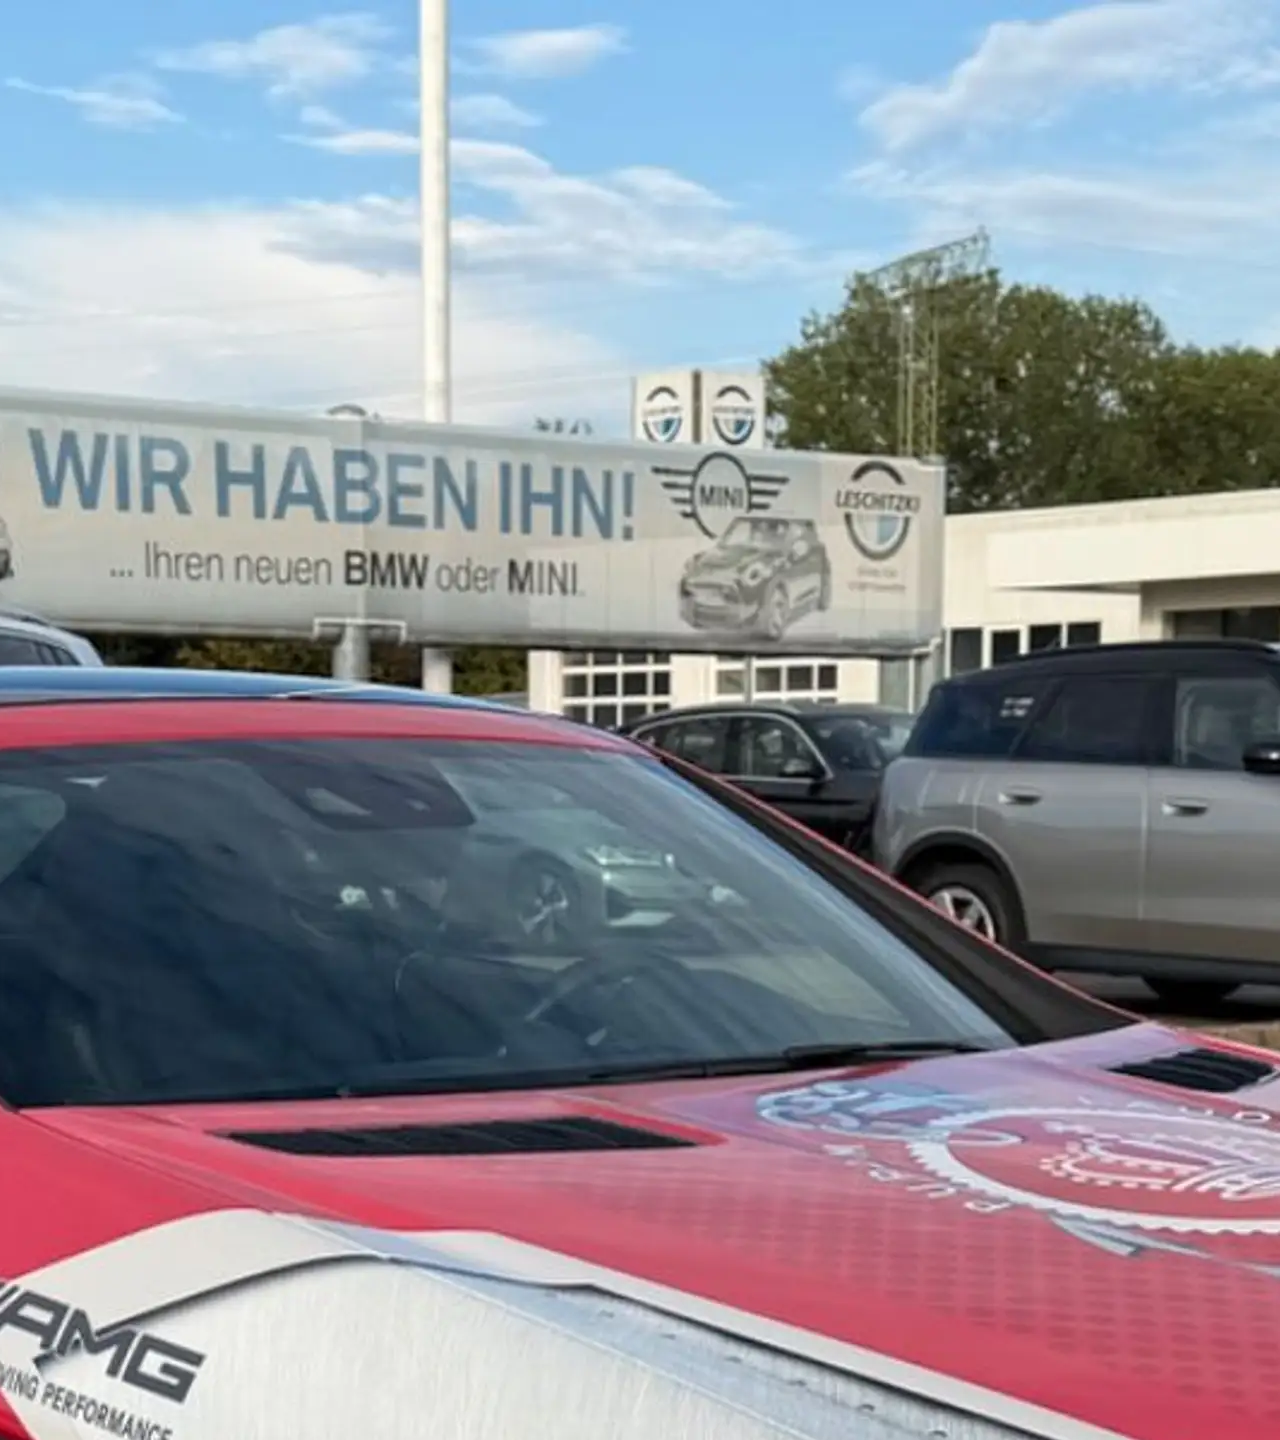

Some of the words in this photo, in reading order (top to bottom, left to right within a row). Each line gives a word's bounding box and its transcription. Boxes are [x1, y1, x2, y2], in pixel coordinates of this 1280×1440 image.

[27, 427, 192, 516] WIR
[215, 440, 477, 533] HABEN
[499, 461, 635, 542] IHN!
[698, 485, 745, 511] MINI
[144, 540, 224, 583] Ihren
[233, 553, 332, 587] neuen
[344, 549, 430, 590] BMW
[435, 557, 501, 593] oder
